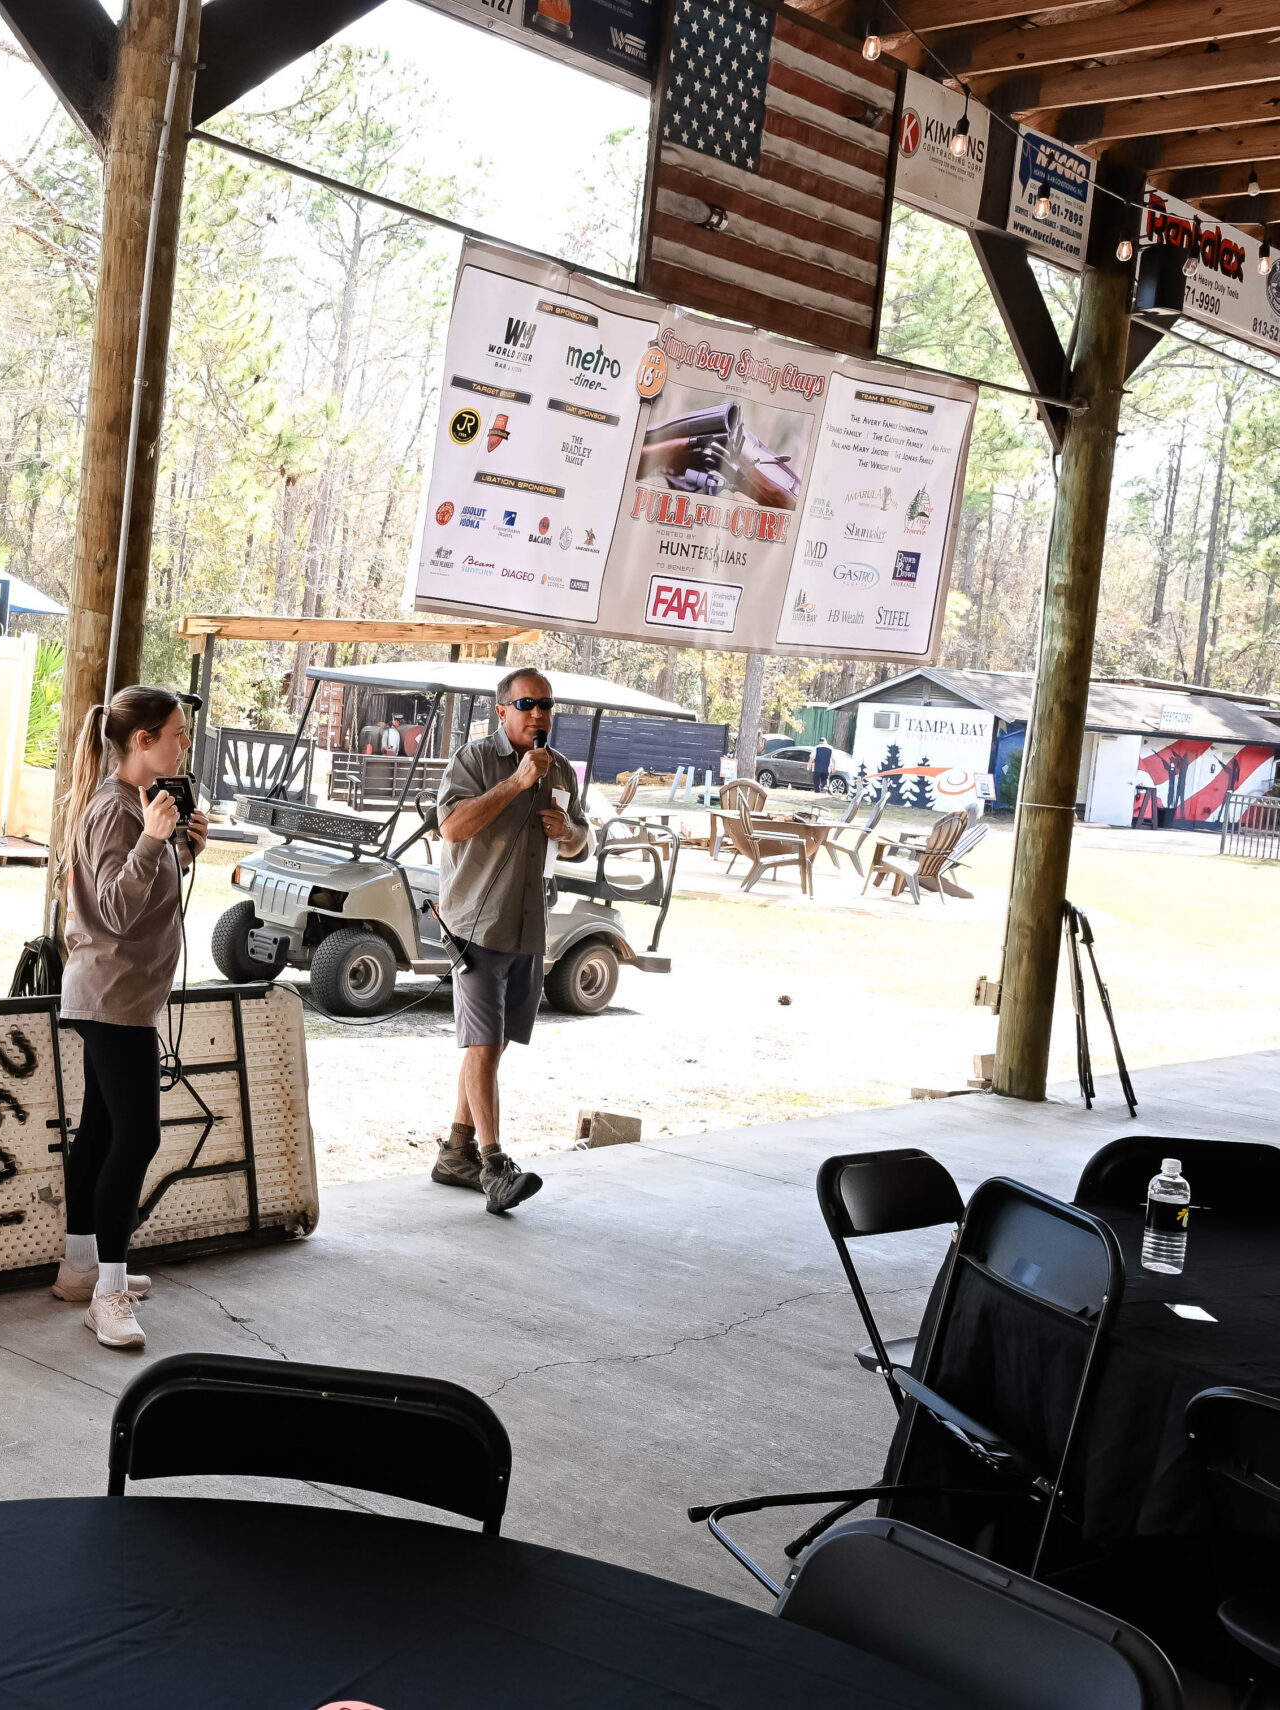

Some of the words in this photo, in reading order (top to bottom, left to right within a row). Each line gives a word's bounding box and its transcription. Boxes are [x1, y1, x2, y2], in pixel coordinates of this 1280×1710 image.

[625, 44, 648, 60] WAYNE
[902, 114, 916, 152] K
[924, 116, 984, 163] KIMNS
[922, 142, 966, 167] CONTRACTING
[1033, 169, 1046, 178] HEATIN
[1028, 192, 1084, 227] 8161-7895
[1013, 220, 1080, 256] www.nuccioac.com
[1198, 272, 1214, 290] Heavy
[1214, 282, 1226, 297] Duty
[1227, 286, 1240, 300] Tools
[1184, 286, 1220, 316] 71-9990
[556, 308, 589, 322] SPONSORS
[1252, 318, 1280, 342] 813-52
[488, 344, 516, 358] WORLD
[648, 353, 661, 364] THE
[566, 344, 621, 378] metro
[661, 328, 696, 369] Tampa
[696, 341, 734, 380] Bay
[737, 349, 781, 392] Sporting
[781, 363, 826, 401] Clays
[472, 383, 499, 396] TARGET
[850, 414, 860, 424] THE
[862, 416, 882, 426] AVERY
[572, 435, 583, 445] THE
[844, 427, 862, 438] FAMILY
[872, 432, 882, 442] THE
[906, 438, 924, 449] FAMILY
[561, 442, 592, 459] BRADLEY
[852, 443, 870, 454] MARY
[564, 454, 584, 466] FAMILY
[858, 459, 868, 468] THE
[482, 474, 515, 487] LIBATION
[518, 482, 557, 495] SPONSORS
[844, 488, 882, 504] AMARULA
[461, 506, 487, 518] ABSOLUT
[631, 487, 694, 527] PULL
[694, 504, 720, 526] FOR
[730, 506, 792, 543] CURE
[459, 518, 480, 530] VODKA
[844, 522, 888, 540] Shumaker
[656, 529, 684, 538] HOSTED
[658, 540, 713, 560] HUNTERS
[720, 552, 748, 566] LIARS
[897, 552, 916, 564] Brown
[462, 555, 495, 569] Beam
[668, 564, 695, 572] BENEFIT
[501, 568, 535, 582] DIAGEO
[834, 565, 875, 583] GASTRO
[896, 566, 916, 578] Brown
[652, 585, 708, 623] FARA
[842, 611, 866, 625] Wealth
[876, 606, 911, 628] STIFEL
[906, 718, 956, 734] TAMPA
[960, 722, 988, 736] BAY
